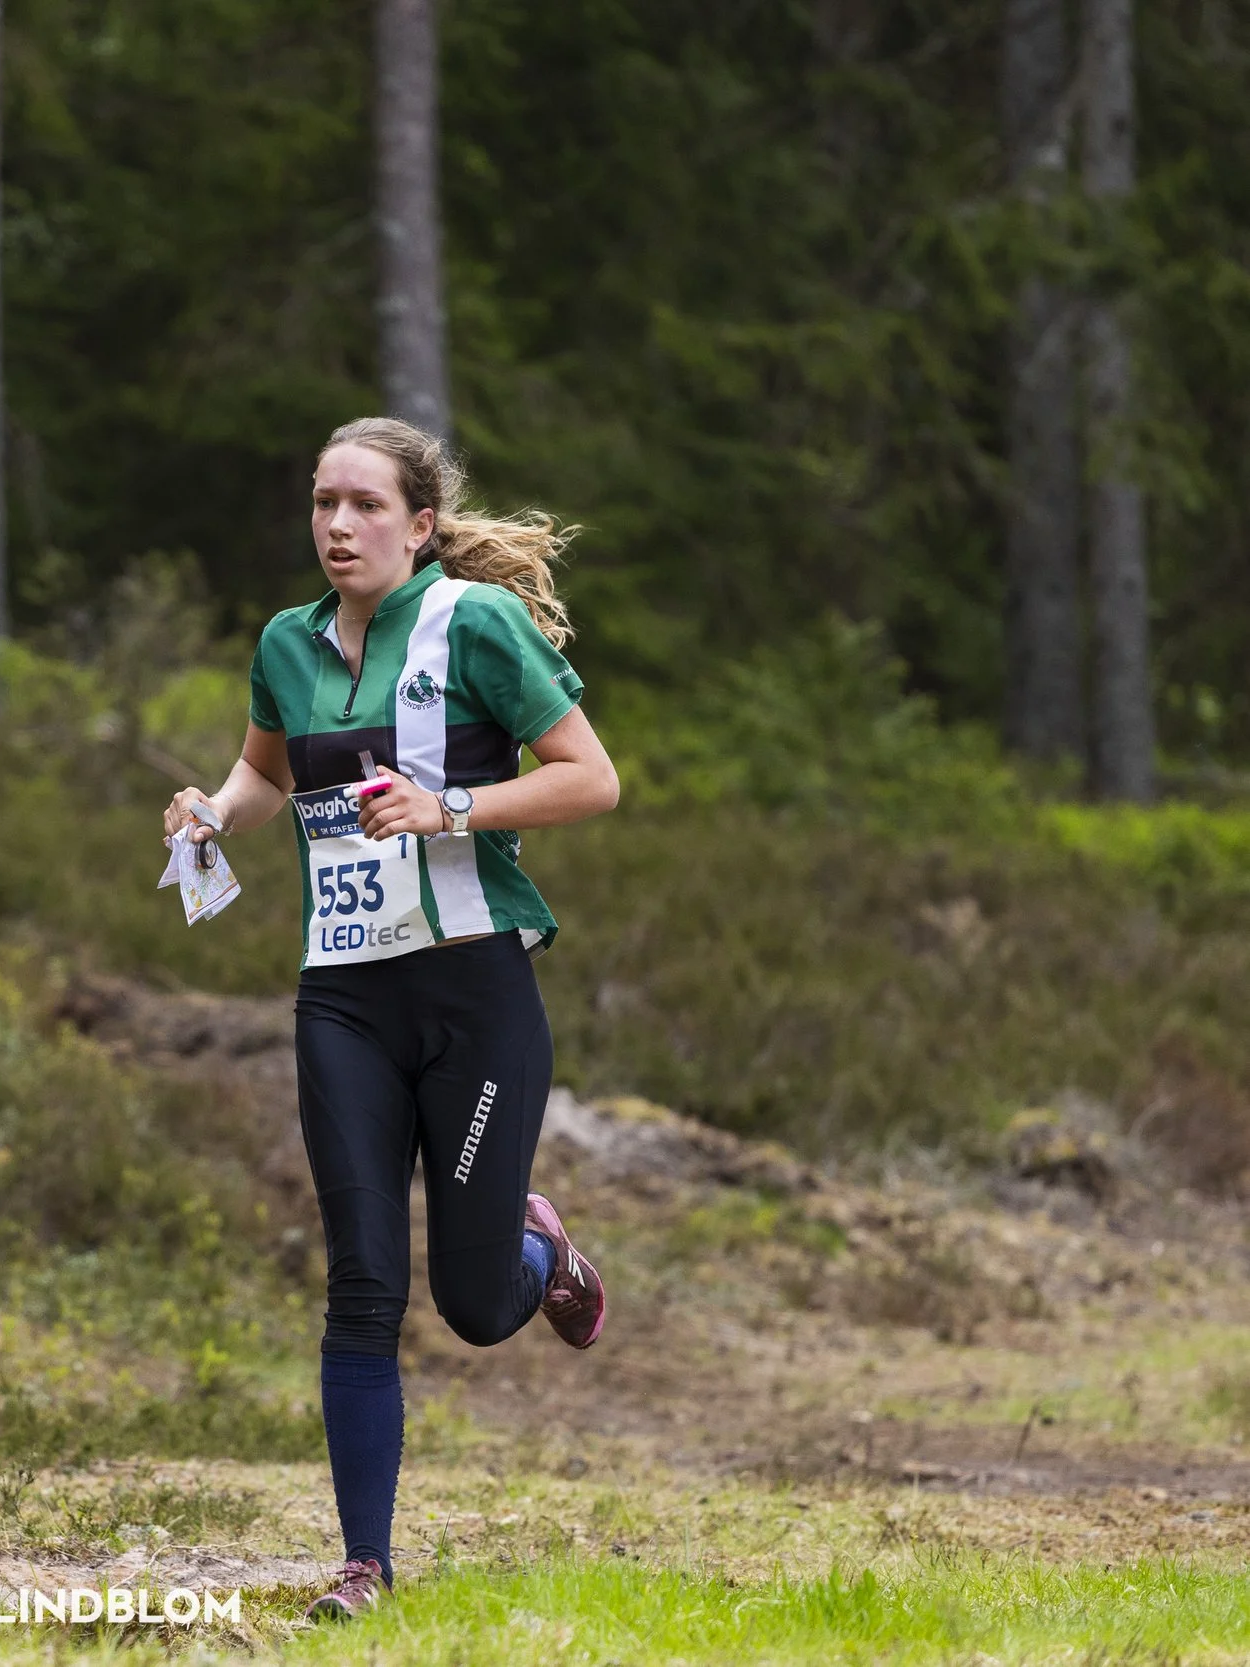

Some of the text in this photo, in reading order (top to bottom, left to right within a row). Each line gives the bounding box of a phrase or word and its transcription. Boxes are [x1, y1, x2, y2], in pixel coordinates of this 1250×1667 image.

[399, 695, 441, 711] SUNDBYBERG
[330, 823, 361, 834] STAFET
[398, 834, 407, 859] 1
[317, 859, 384, 918] 553
[321, 922, 411, 952] LEDtec
[454, 1080, 498, 1184] noname
